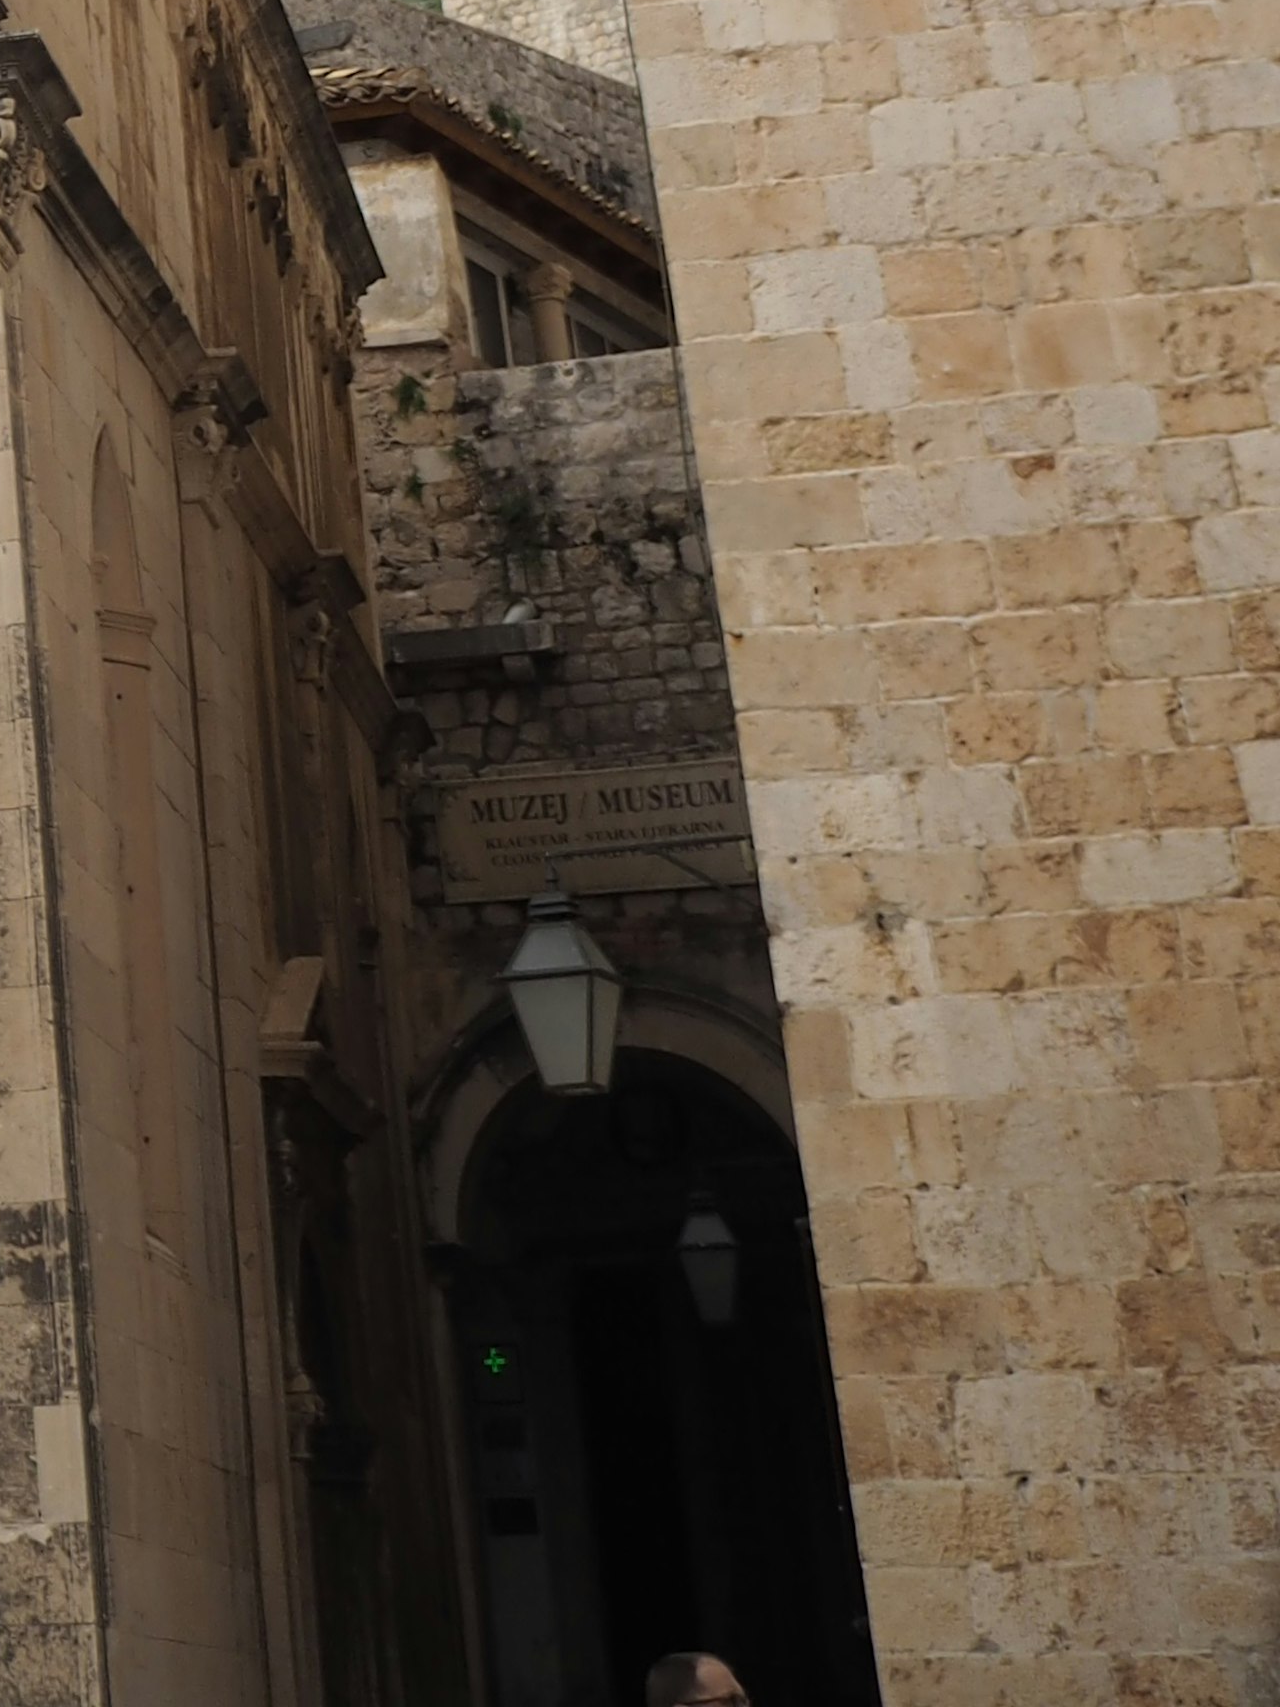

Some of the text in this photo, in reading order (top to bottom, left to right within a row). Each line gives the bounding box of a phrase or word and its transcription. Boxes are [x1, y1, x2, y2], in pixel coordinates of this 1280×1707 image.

[470, 792, 568, 825] MUZEJ
[597, 779, 737, 815] MUSEUM
[584, 828, 638, 842] STARA
